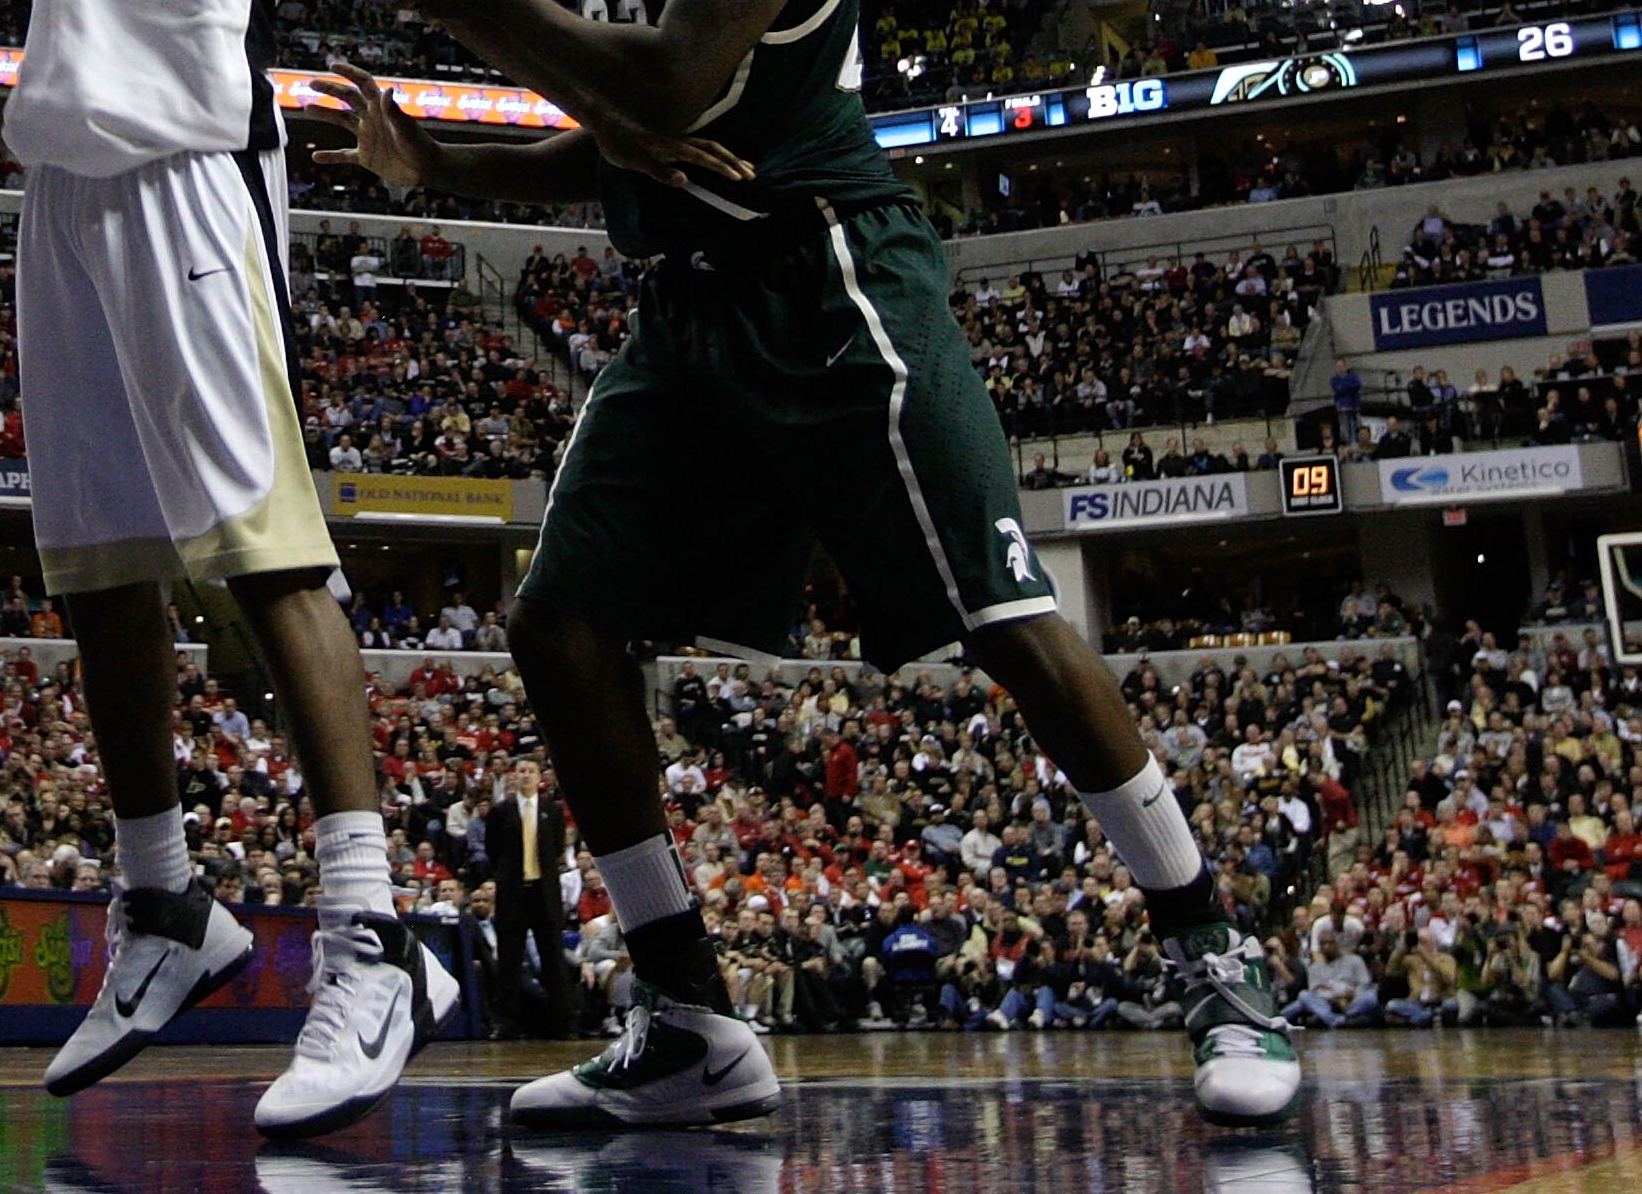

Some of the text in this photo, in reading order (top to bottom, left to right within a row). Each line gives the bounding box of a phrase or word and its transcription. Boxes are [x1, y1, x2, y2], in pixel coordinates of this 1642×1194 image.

[1517, 22, 1573, 62] 26
[941, 114, 959, 137] 4
[1014, 106, 1033, 128] 3
[1379, 292, 1539, 335] LEGENDS
[1292, 465, 1329, 496] 09
[1461, 460, 1570, 483] Kinetico
[1111, 481, 1235, 518] INDIANA
